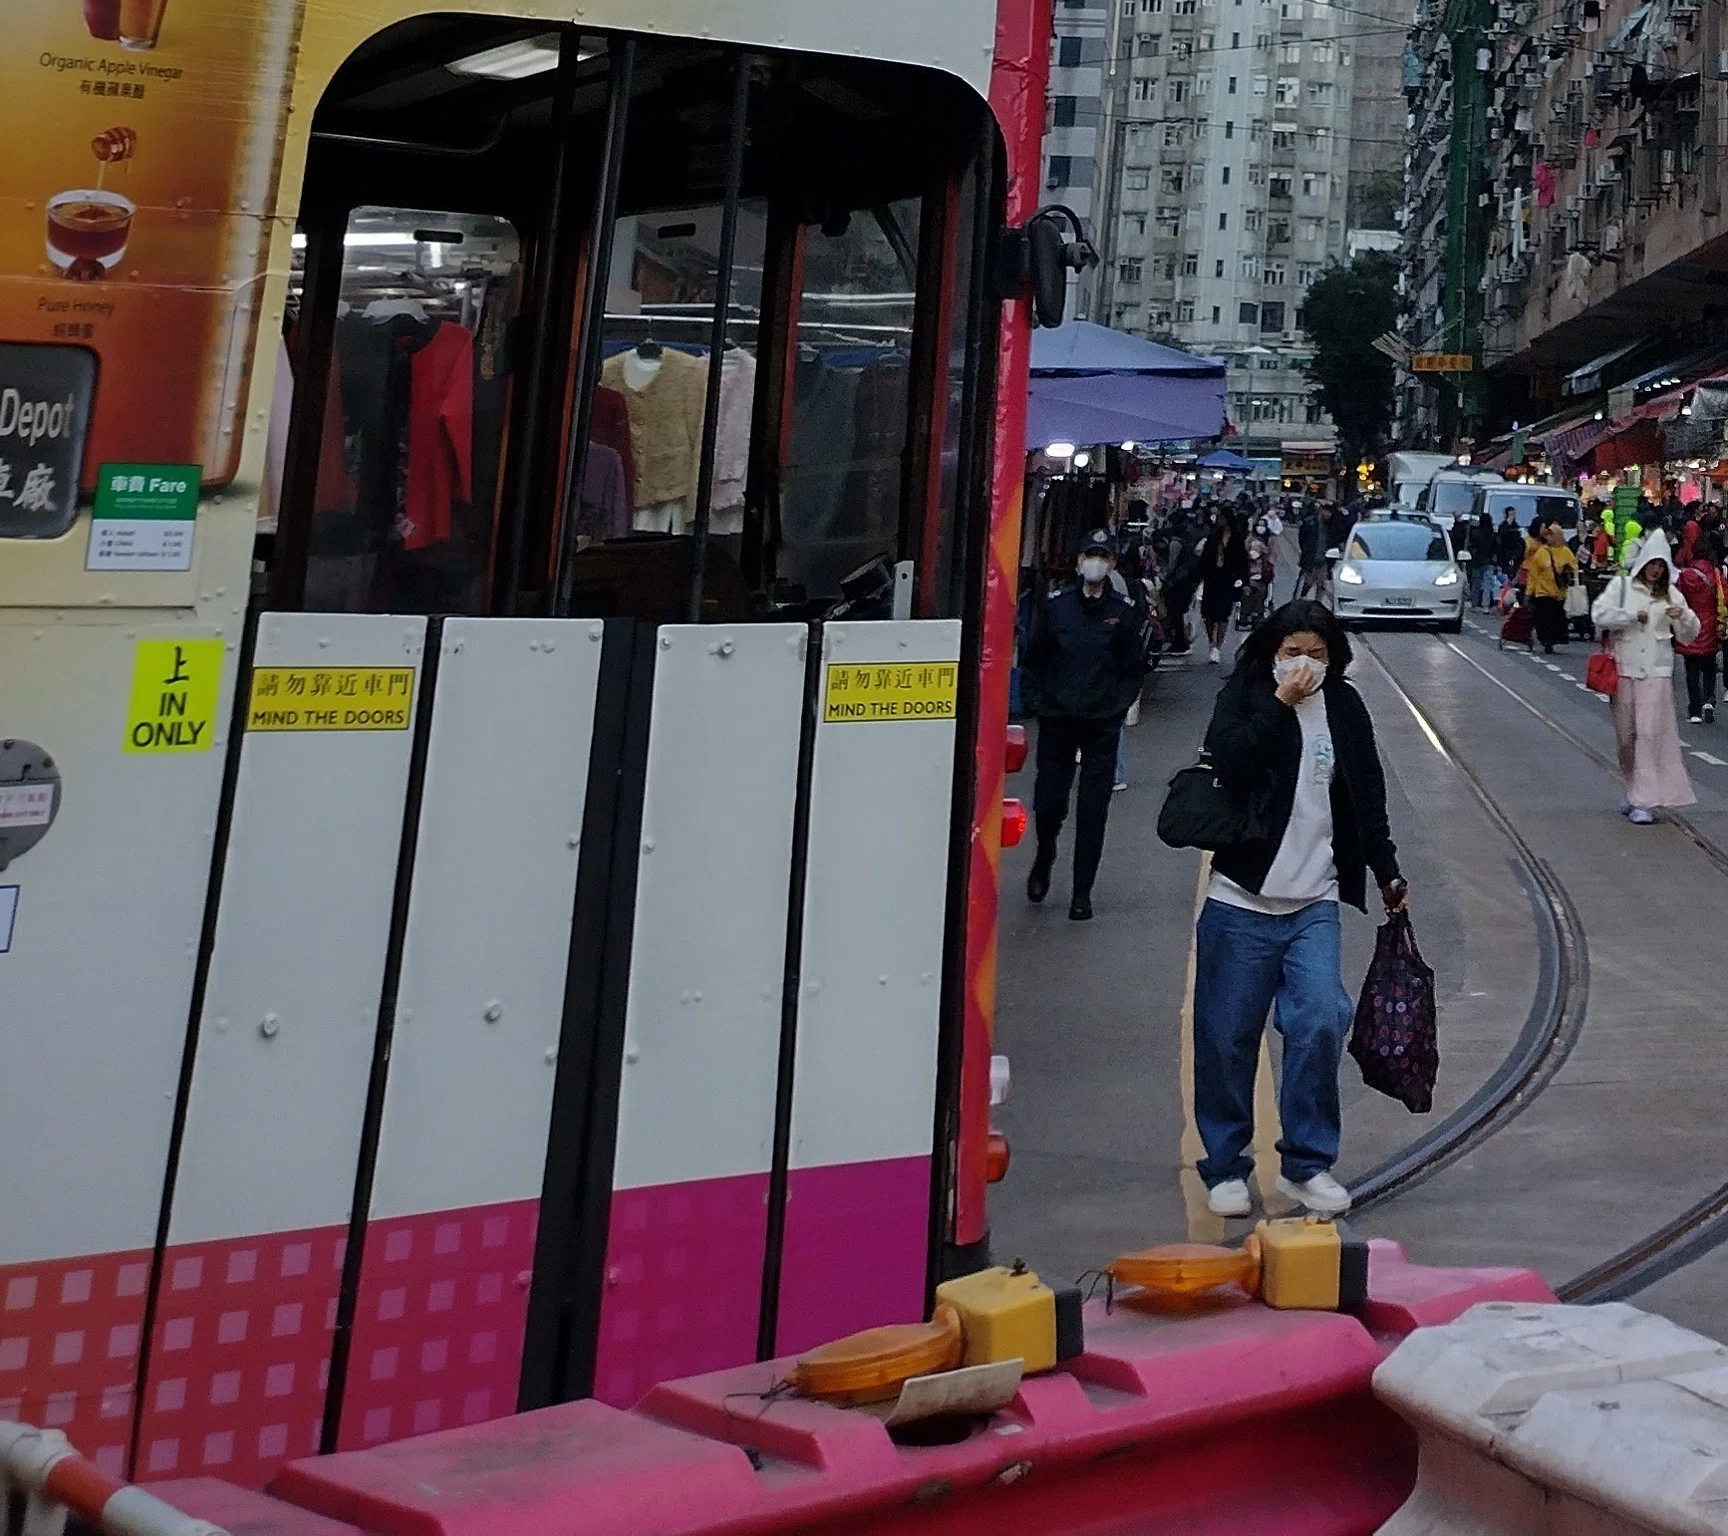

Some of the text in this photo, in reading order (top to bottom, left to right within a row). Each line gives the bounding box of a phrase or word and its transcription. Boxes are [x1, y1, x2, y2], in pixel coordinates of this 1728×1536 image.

[39, 52, 183, 82] Organic Apple Vinegar
[0, 388, 75, 447] Depot
[148, 478, 188, 493] Fare
[164, 646, 190, 684] 上
[257, 673, 409, 697] 請勿靠近車門
[831, 667, 955, 690] 請勿靠近車門
[159, 692, 186, 717] IN
[828, 701, 952, 717] MIND THE DOORS
[253, 709, 404, 726] MIND THE DOORS
[132, 720, 206, 747] ONLY
